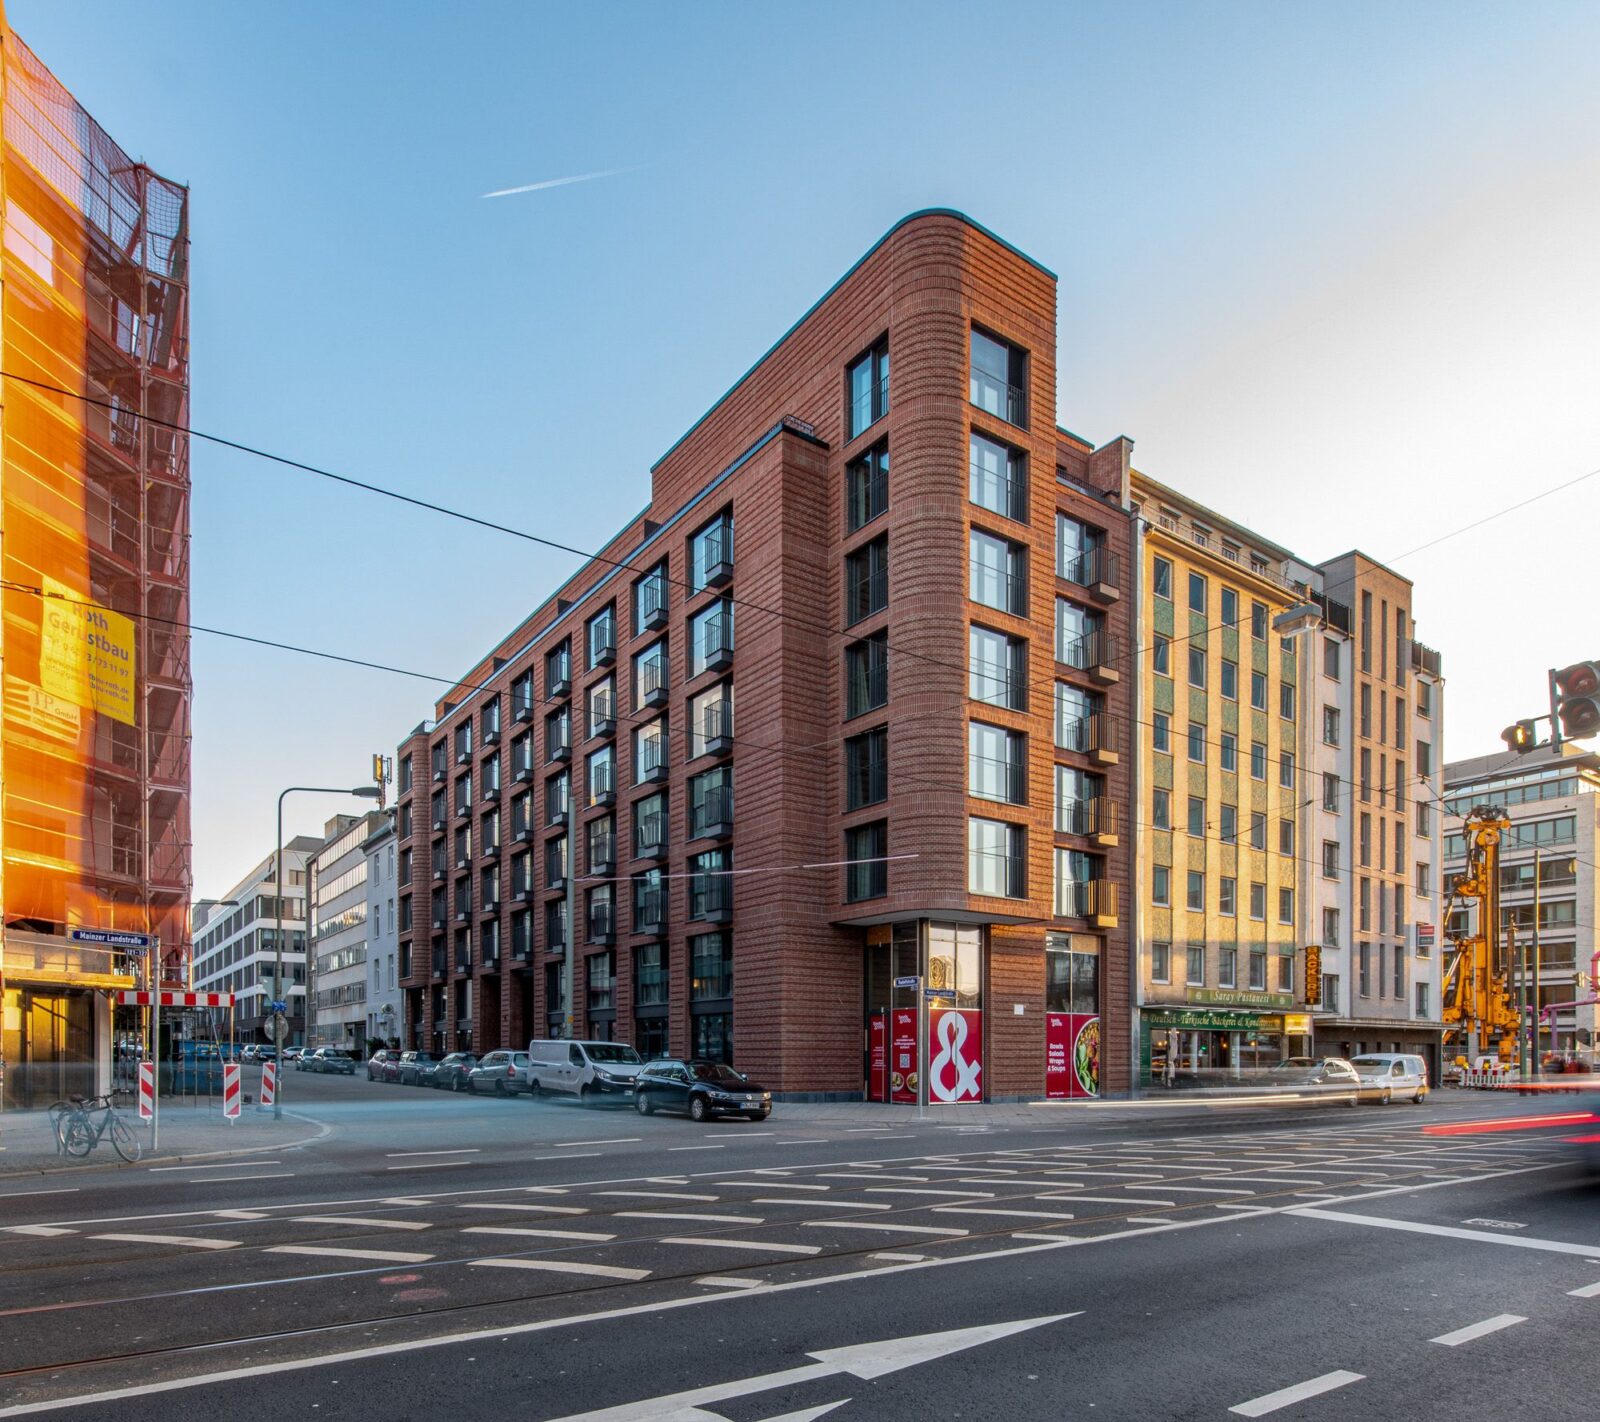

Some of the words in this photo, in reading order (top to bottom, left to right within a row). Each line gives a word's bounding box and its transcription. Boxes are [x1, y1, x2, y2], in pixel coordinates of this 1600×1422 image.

[80, 932, 105, 941] Mainzer
[107, 935, 142, 945] Landstraße
[1214, 991, 1235, 1004] Saray
[1237, 992, 1270, 1003] Pastanesi
[930, 1011, 982, 1101] &
